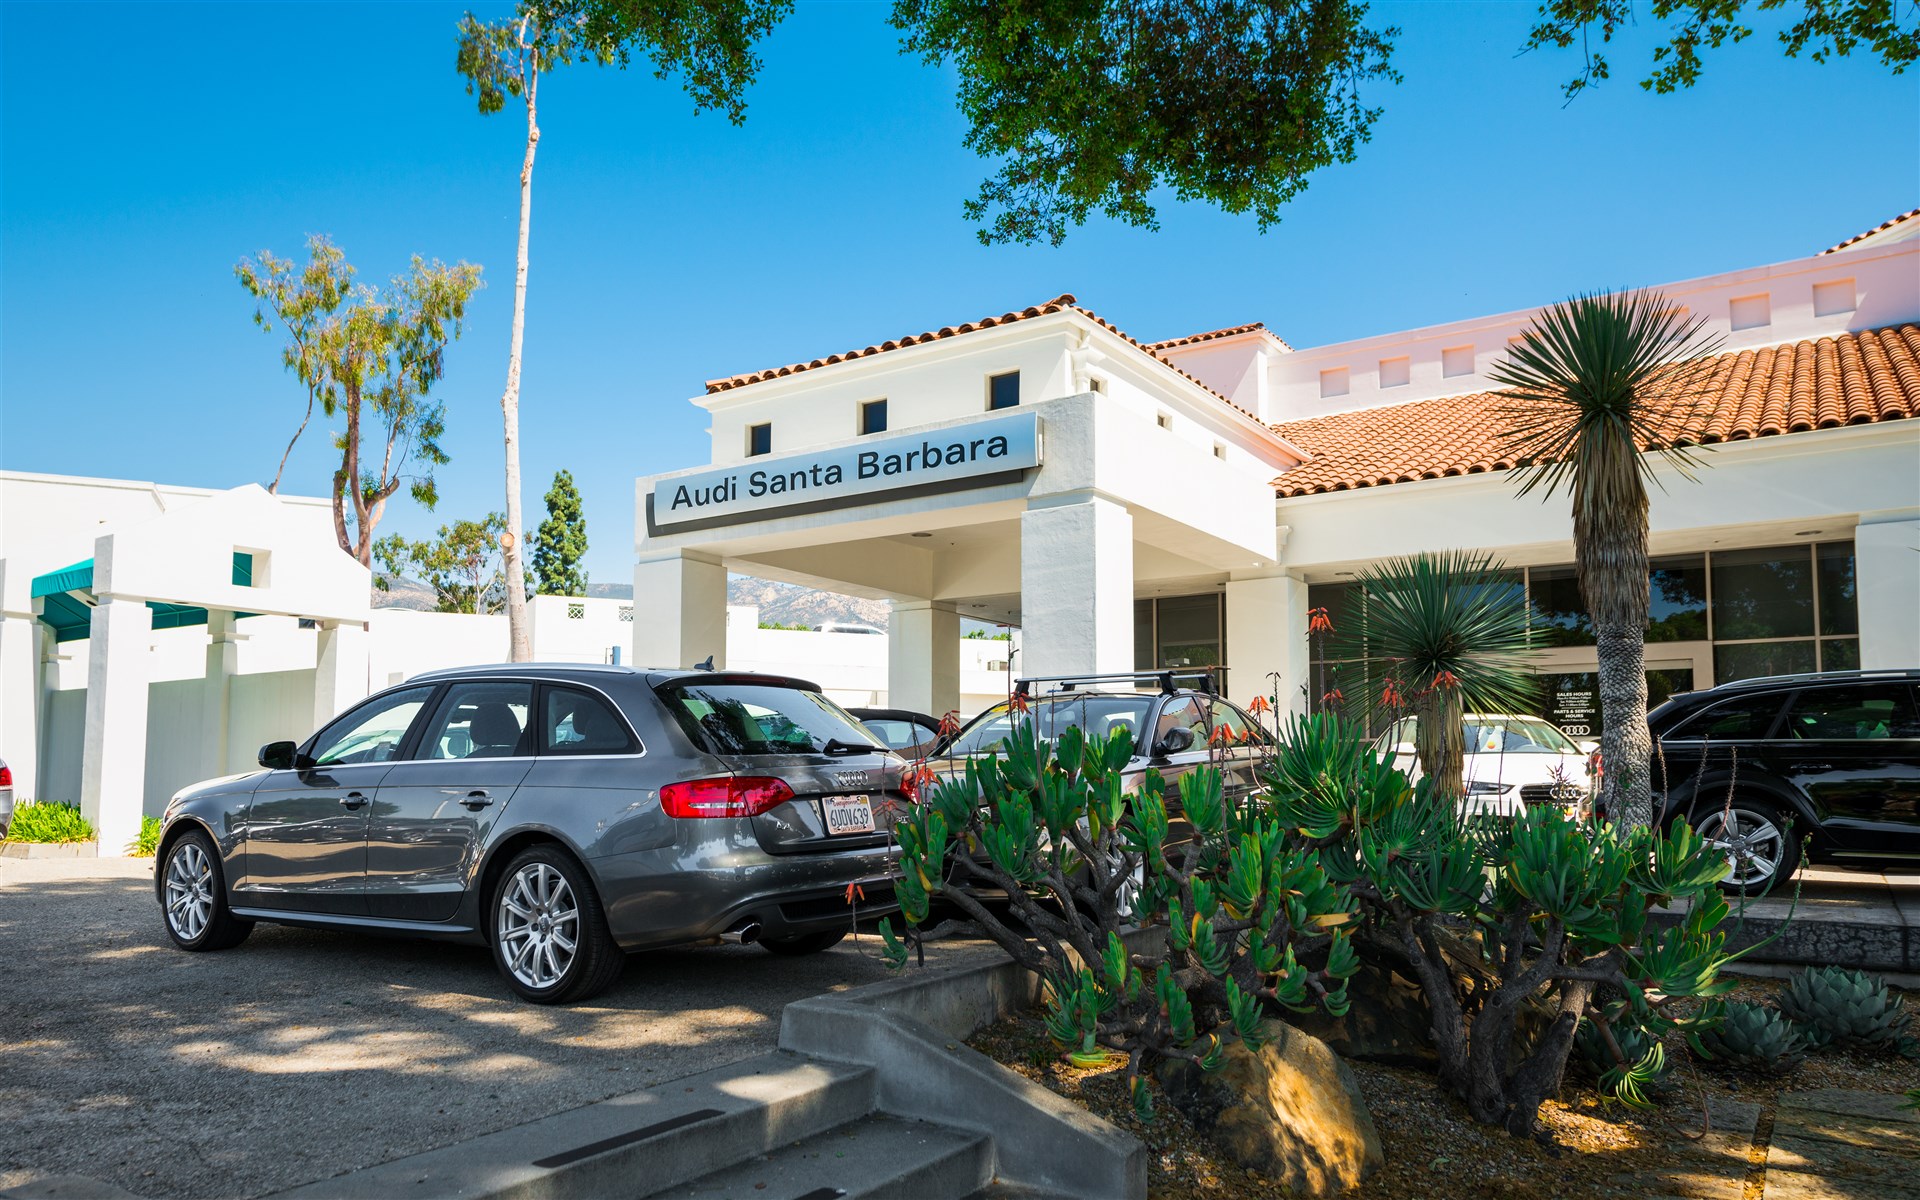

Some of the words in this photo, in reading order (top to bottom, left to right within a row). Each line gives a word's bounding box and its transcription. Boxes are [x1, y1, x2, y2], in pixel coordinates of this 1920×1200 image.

[670, 475, 737, 511] Audi
[748, 462, 843, 497] Santa
[857, 435, 1009, 480] Barbara
[830, 807, 869, 827] 6UDV639
